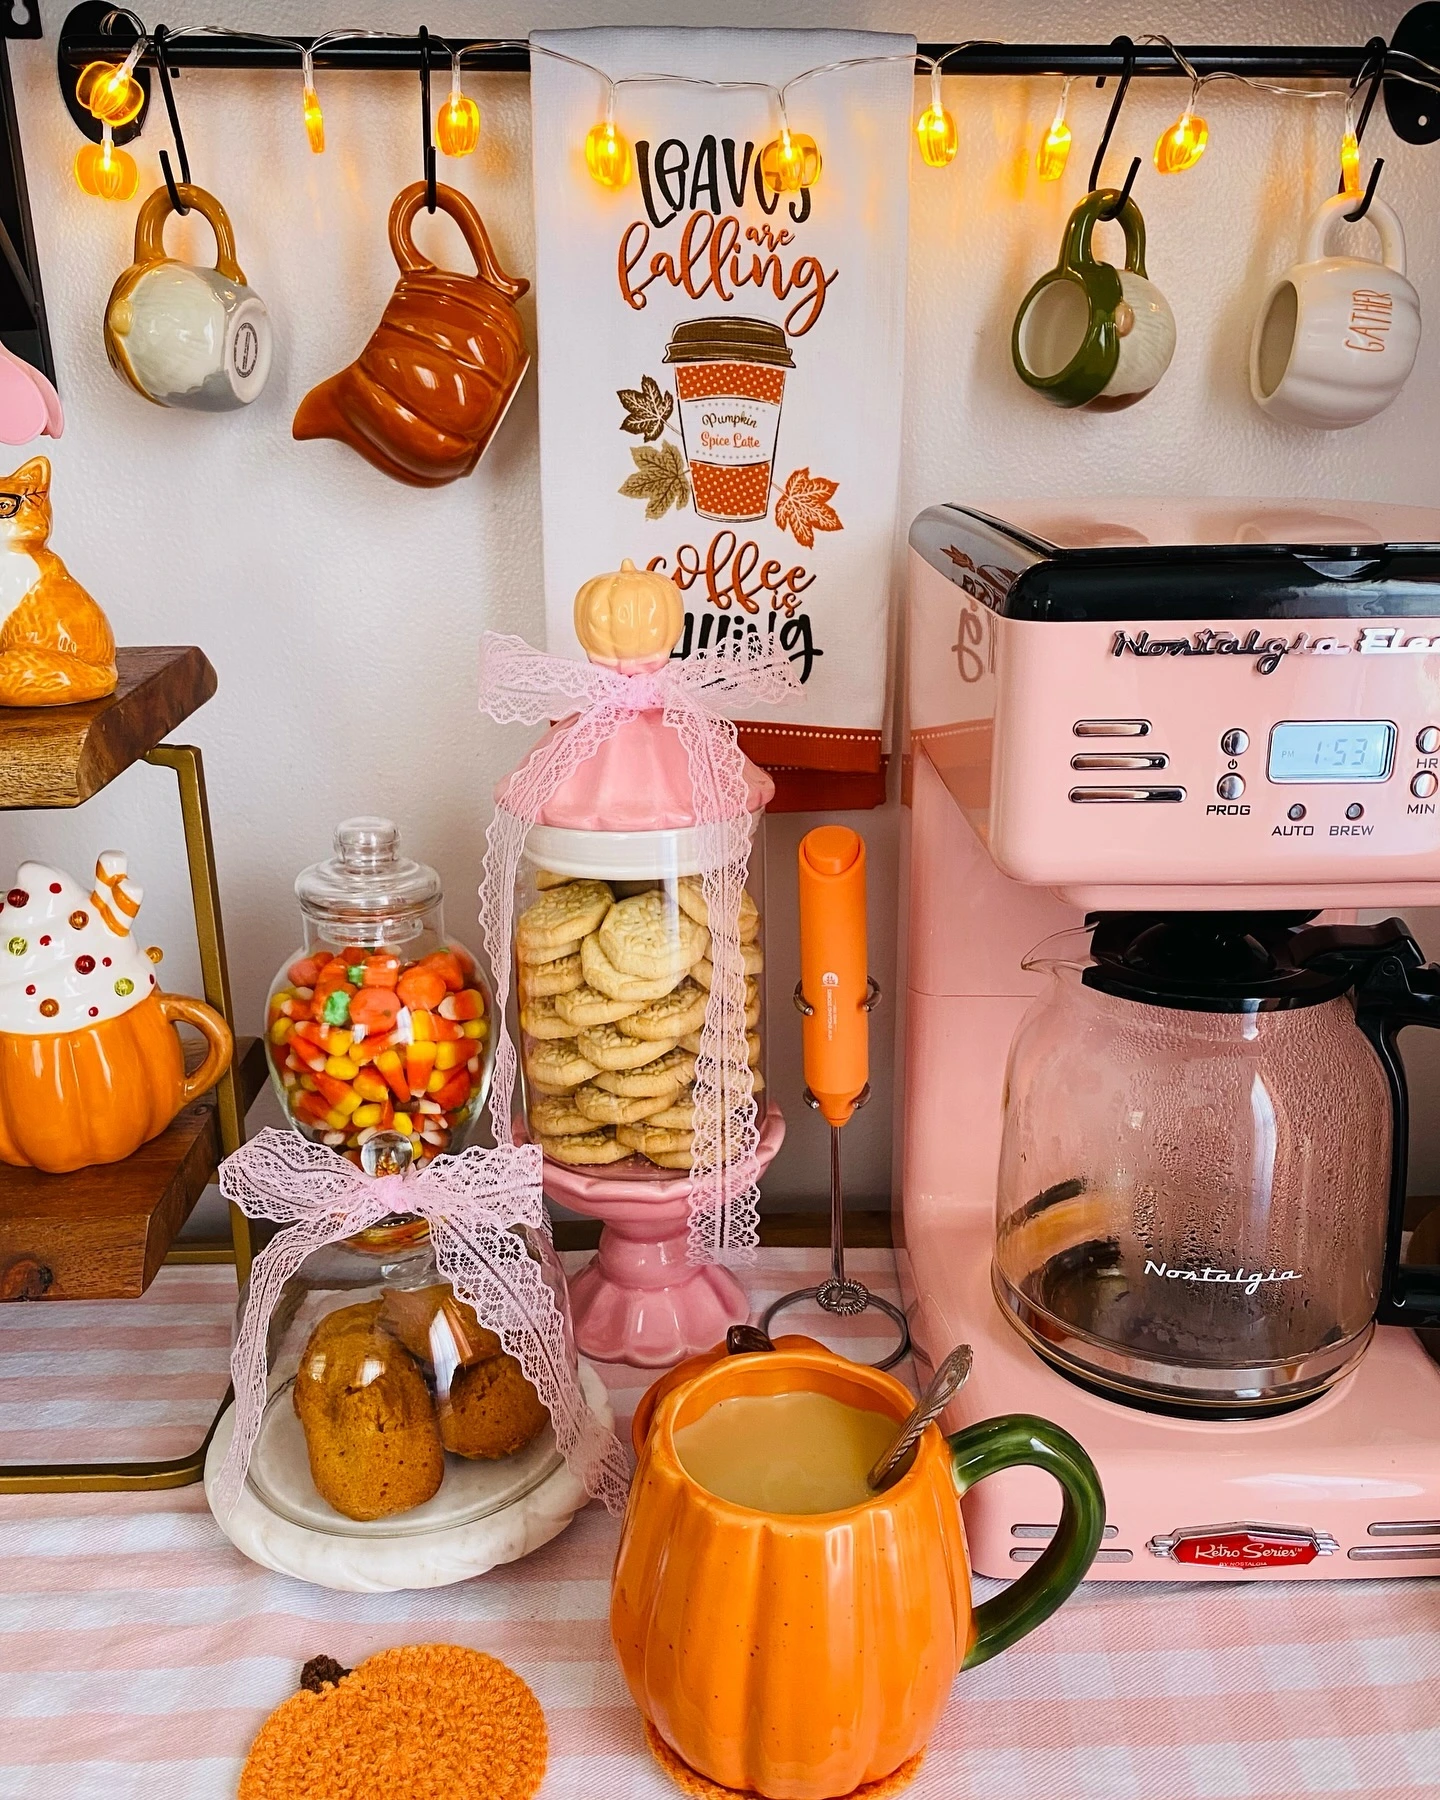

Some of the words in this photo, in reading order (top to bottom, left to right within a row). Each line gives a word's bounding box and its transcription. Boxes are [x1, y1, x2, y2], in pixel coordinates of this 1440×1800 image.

[745, 223, 796, 252] are
[618, 210, 839, 336] falling
[1345, 289, 1393, 352] GATHER
[702, 411, 757, 428] Pumpkin
[701, 431, 729, 450] Spice
[733, 433, 760, 448] Latte
[771, 590, 802, 618] is
[1112, 628, 1352, 675] Nostalgia
[1281, 750, 1295, 759] PM
[1314, 738, 1368, 766] 1:53
[1416, 758, 1439, 769] HR
[1206, 804, 1251, 816] PROG
[1407, 803, 1436, 815] MIN
[1271, 825, 1314, 836] AUTO
[1329, 825, 1375, 836] BREW
[1144, 1260, 1303, 1295] Nostalgia
[1195, 1544, 1240, 1559] Retro
